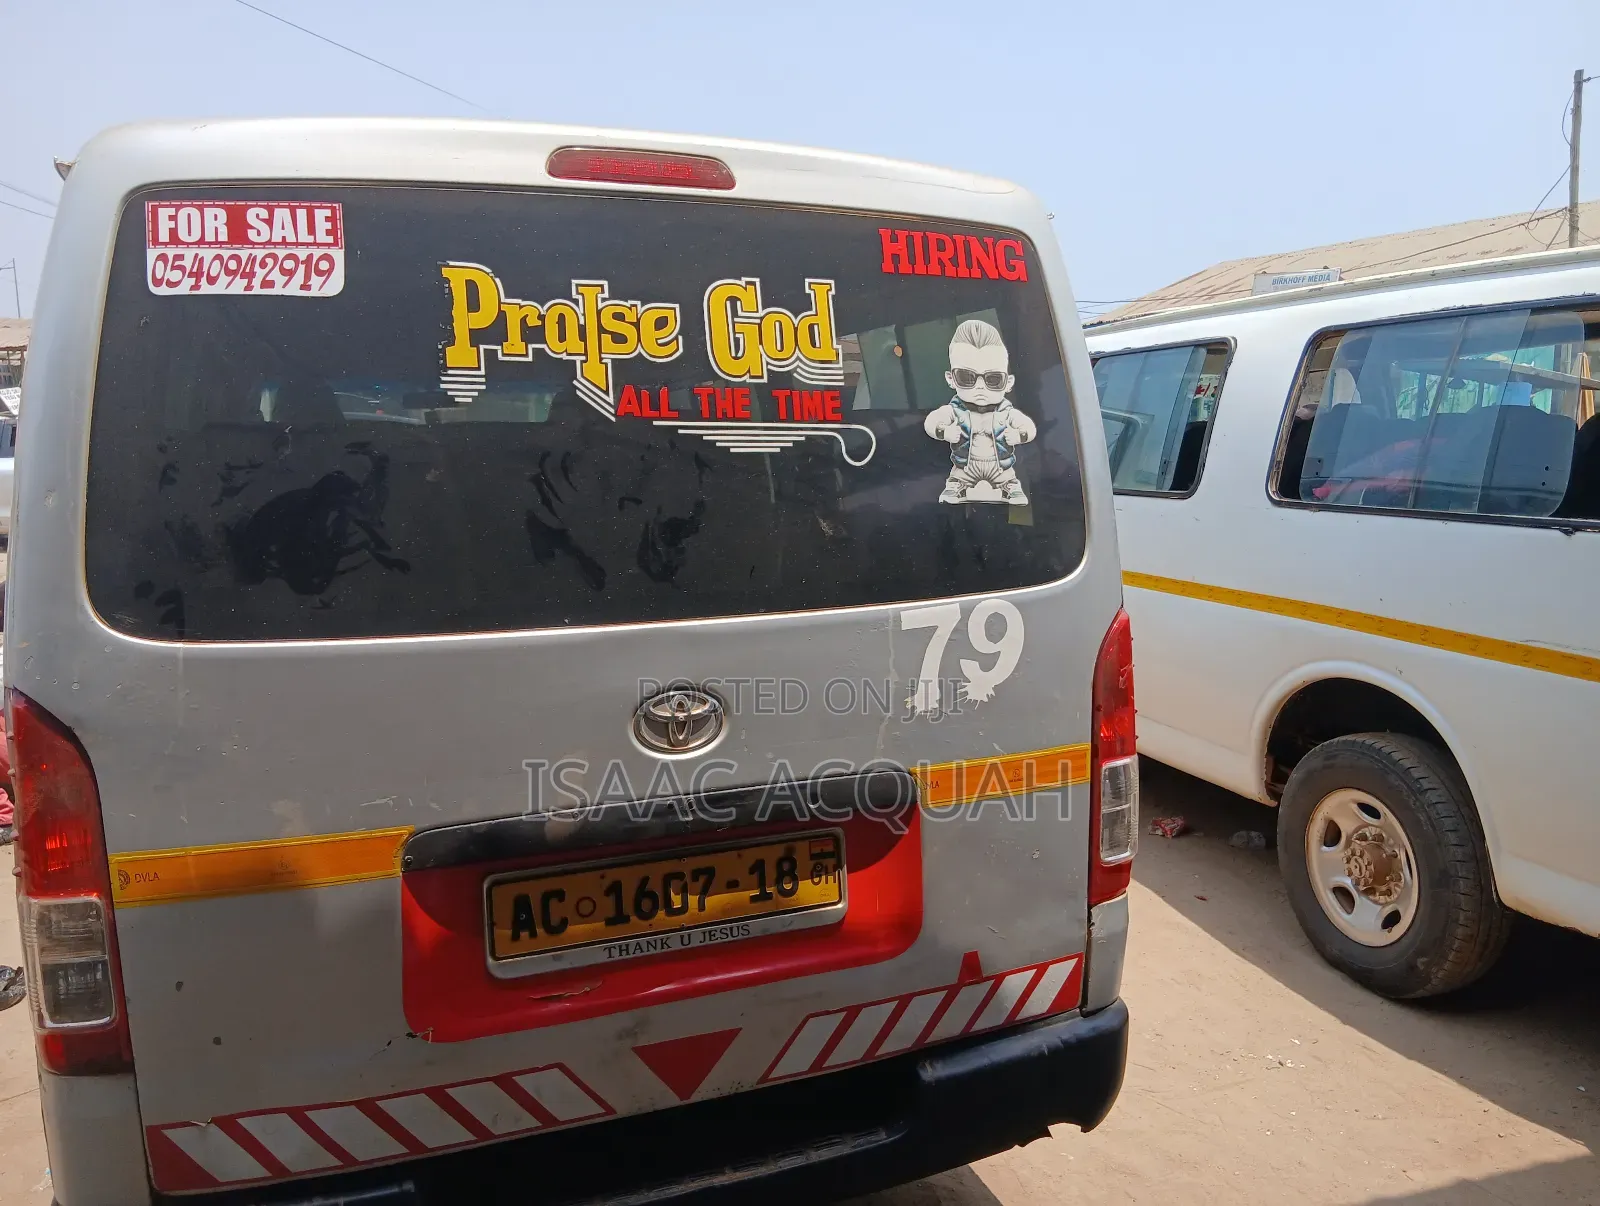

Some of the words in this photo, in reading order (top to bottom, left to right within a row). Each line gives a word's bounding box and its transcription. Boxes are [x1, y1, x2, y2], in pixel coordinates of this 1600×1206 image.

[157, 206, 229, 243] FOR
[246, 207, 334, 243] SALE
[151, 252, 336, 292] 0540942919
[878, 228, 1028, 282] HIRING
[1271, 276, 1306, 286] BIRKHOFF
[1307, 273, 1331, 283] MEDIA
[704, 277, 841, 382] God
[616, 384, 679, 418] ALL
[694, 387, 751, 419] THE
[772, 389, 843, 421] TIME
[900, 599, 1024, 716] 79
[134, 871, 160, 884] DVLA
[510, 888, 569, 942] AC
[603, 936, 672, 960] THANK
[680, 932, 692, 947] U
[699, 923, 751, 944] JESUS
